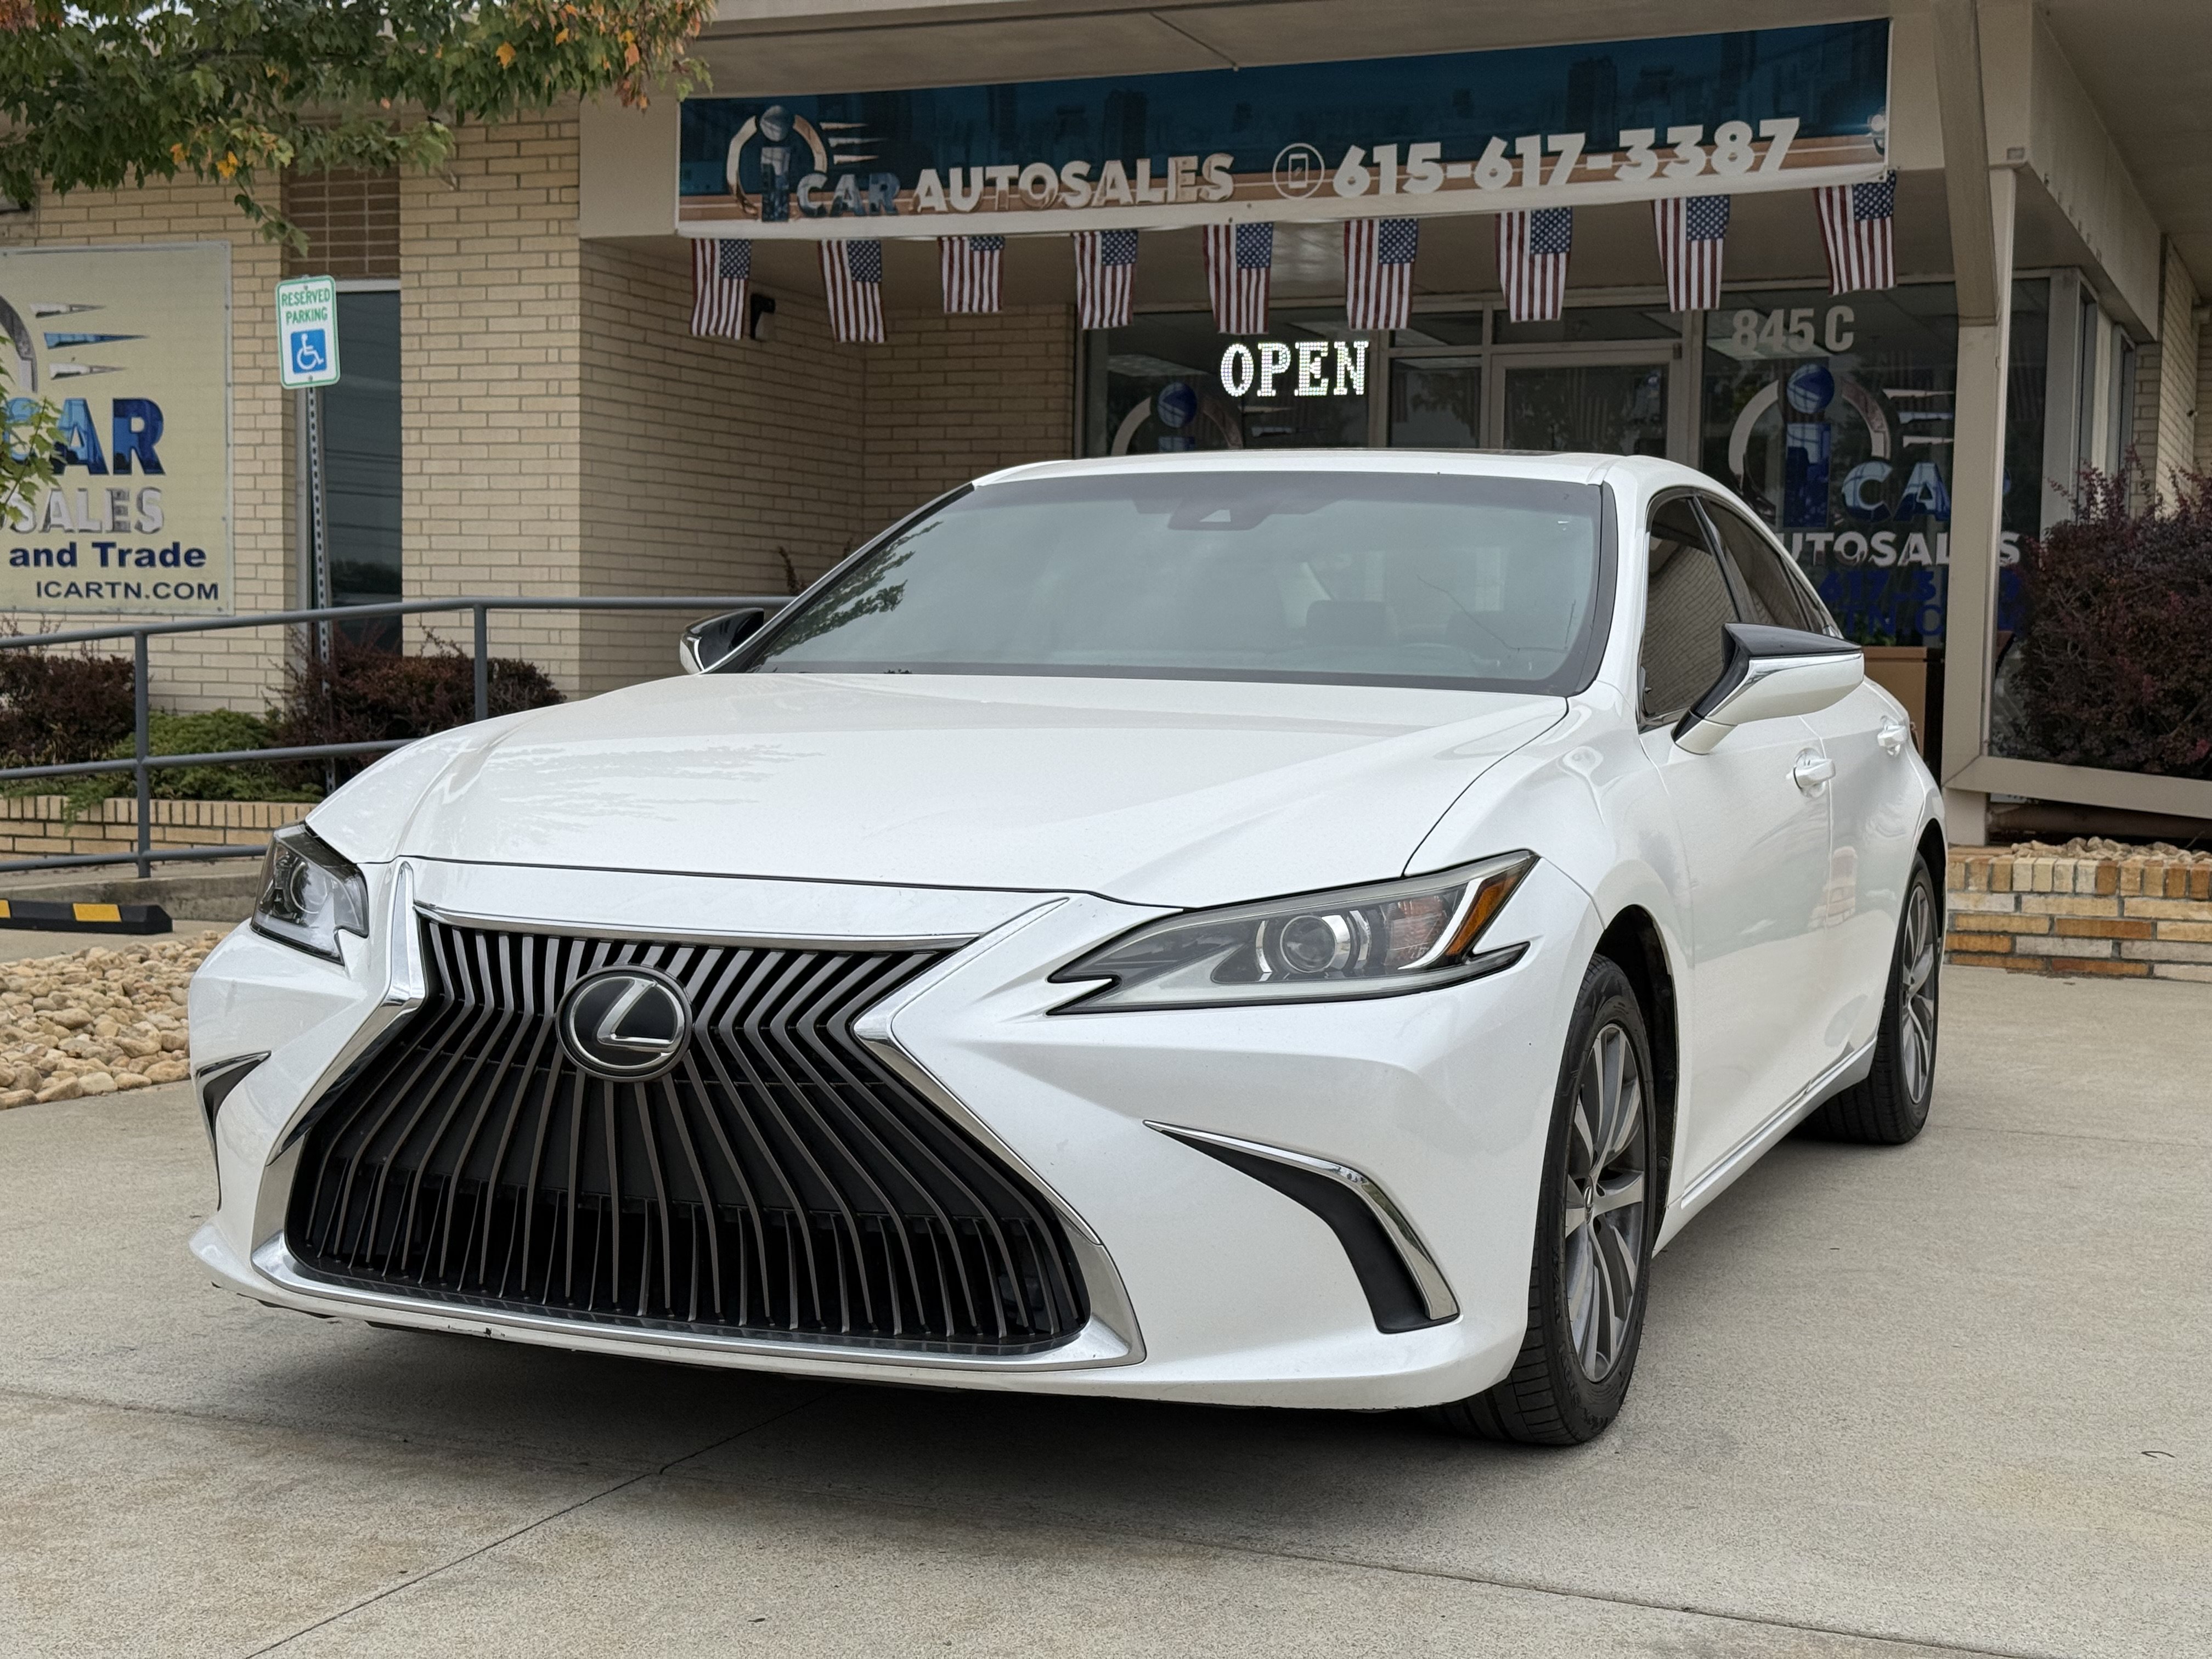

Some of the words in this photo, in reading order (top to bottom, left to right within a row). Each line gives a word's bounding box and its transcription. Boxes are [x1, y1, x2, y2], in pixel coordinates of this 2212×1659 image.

[796, 172, 901, 218] CAR
[910, 153, 1234, 213] AUTOSALES
[1332, 117, 1800, 196] 615-617-3387
[281, 288, 330, 307] RESERVED
[285, 307, 328, 325] PARKING
[1731, 308, 1815, 354] 845
[1825, 305, 1855, 352] C
[1220, 341, 1369, 397] OPEN
[0, 487, 164, 534] SALES
[9, 541, 77, 568] and
[92, 541, 206, 568] Trade
[36, 581, 219, 600] ICARTN.COM
